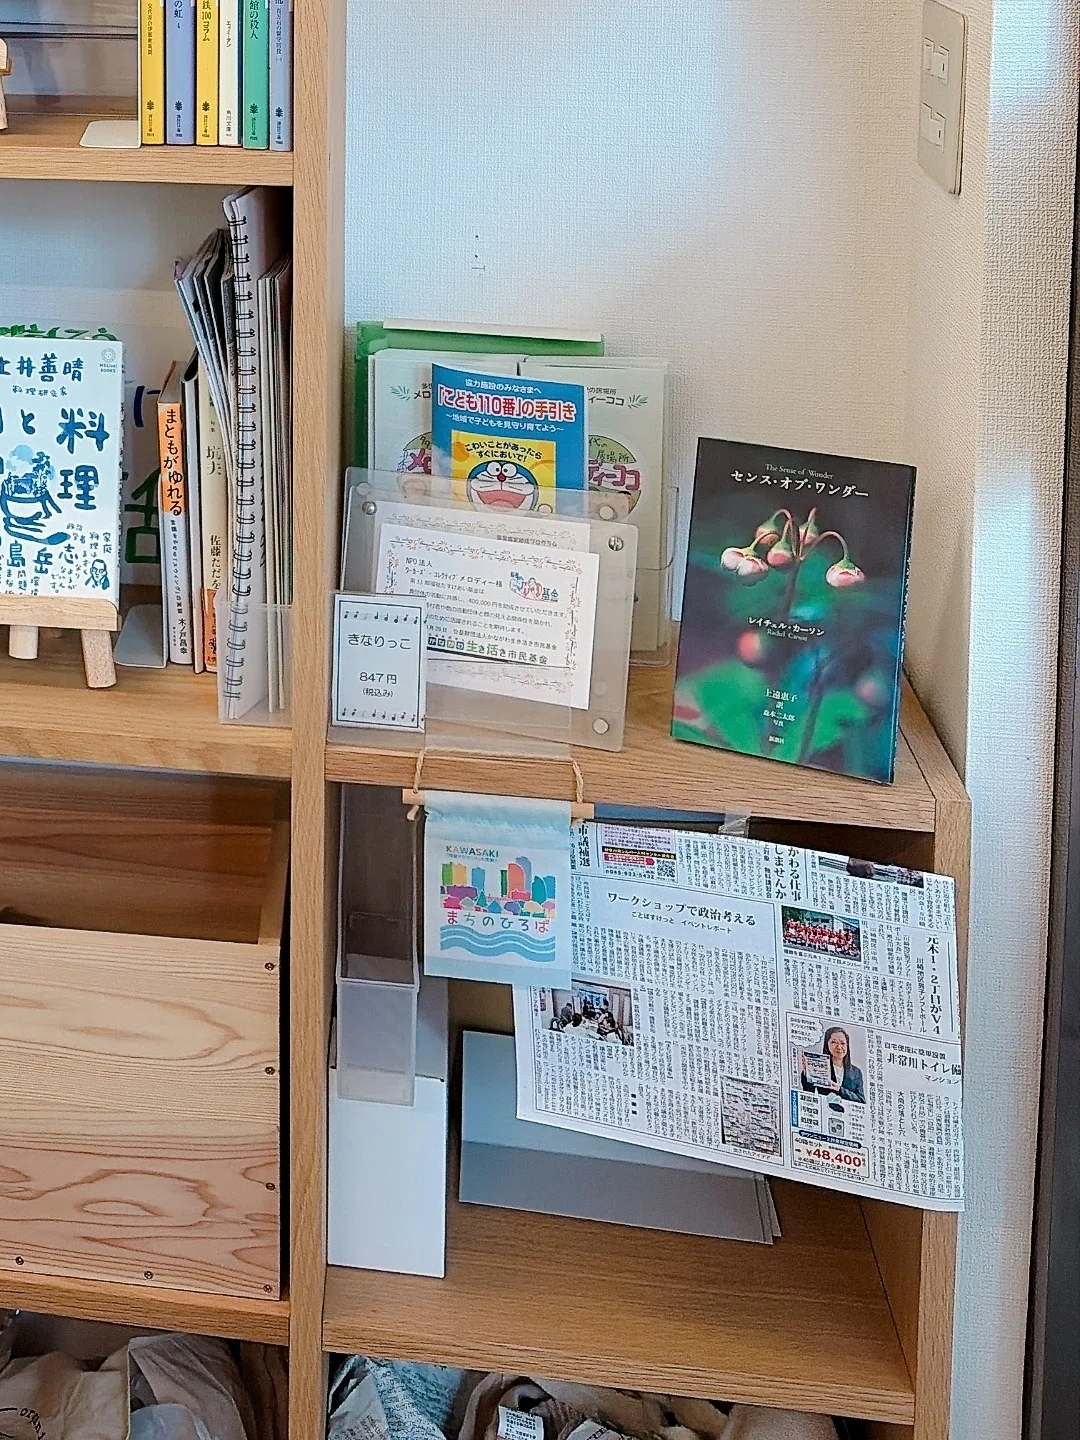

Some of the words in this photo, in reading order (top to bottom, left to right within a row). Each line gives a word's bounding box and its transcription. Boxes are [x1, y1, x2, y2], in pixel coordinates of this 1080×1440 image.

[12, 384, 68, 397] 料理研究家
[465, 378, 542, 395] 協力施設のみなさまへ
[437, 385, 576, 422] 「こども110番」の手引き
[446, 413, 564, 433] 〜地域で子どもを見守り育てよう〜
[56, 407, 110, 510] 料理
[465, 440, 544, 461] こわいことがあったら
[476, 451, 528, 463] すぐにおいで!
[164, 409, 182, 516] まともがゆれる
[765, 463, 777, 472] The
[778, 465, 797, 475] Sense
[799, 467, 806, 477] of
[731, 470, 869, 499] センス・オブ・ワンダー
[210, 534, 222, 589] 佐藤ただを
[405, 556, 417, 565] NPO
[419, 557, 433, 568] 法人
[459, 574, 503, 588] メロディー様
[177, 618, 187, 654] 木ノ戸昌幸
[748, 616, 824, 636] レイチェル・カーソン
[348, 633, 412, 651] きなりっこ
[787, 632, 808, 642] Carson
[361, 687, 394, 698] (税込み)
[765, 688, 797, 702] 上遠恵子
[776, 701, 784, 710] 訳
[446, 845, 499, 858] KAWASAKI
[774, 845, 788, 900] しませんか
[608, 892, 756, 927] ワークショップで政治考える
[447, 911, 550, 934] まちのひろば
[632, 911, 675, 925] ことばすけっと
[682, 920, 732, 934] イベントレポート
